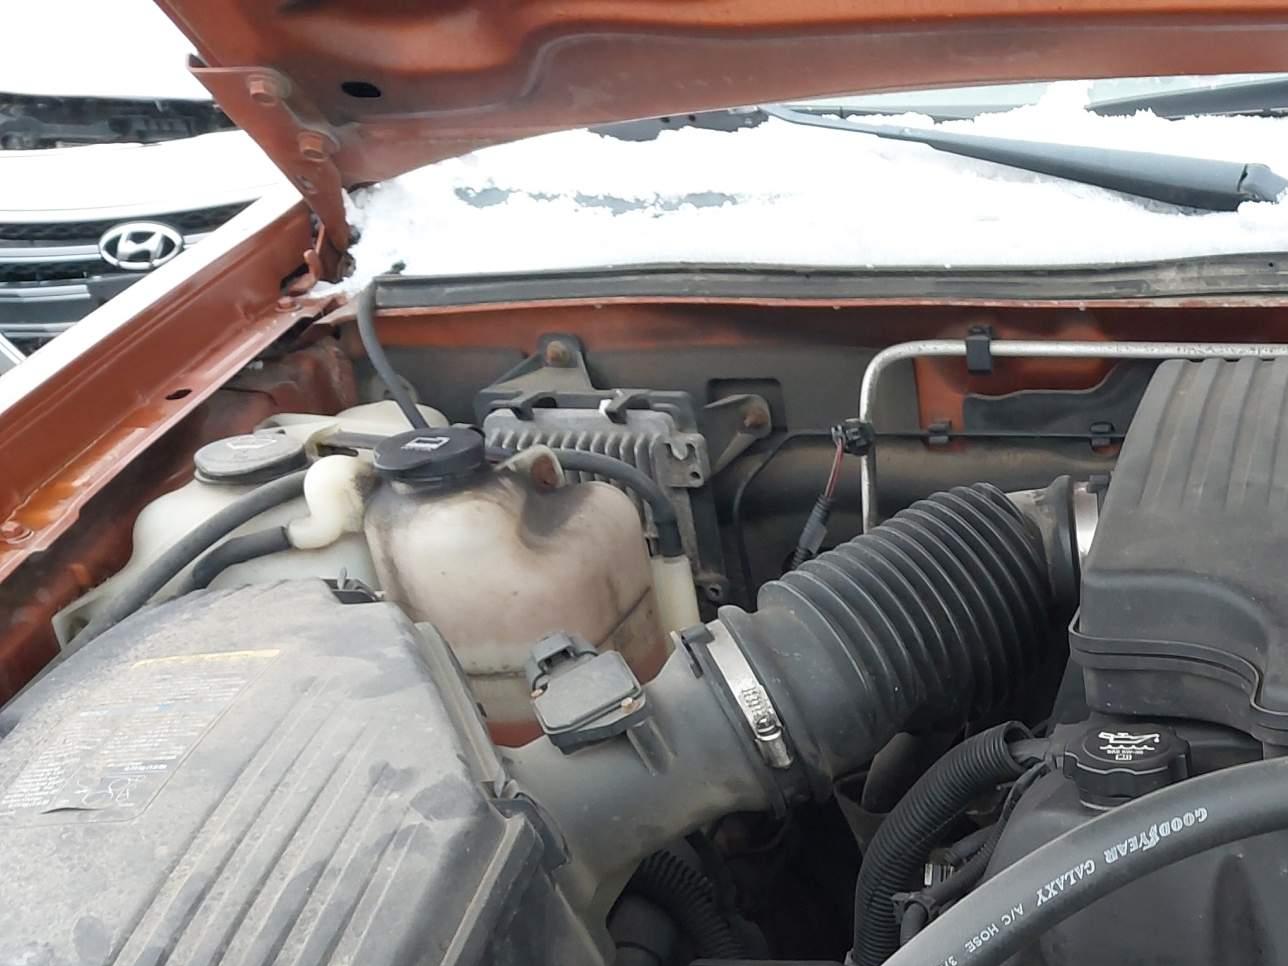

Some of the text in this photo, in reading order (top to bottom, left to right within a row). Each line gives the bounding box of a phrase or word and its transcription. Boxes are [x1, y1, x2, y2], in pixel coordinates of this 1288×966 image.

[1103, 807, 1209, 865] GOODYEAR
[1036, 859, 1096, 907] GALAXY
[1001, 903, 1024, 926] A/C
[964, 923, 1000, 953] HOSE
